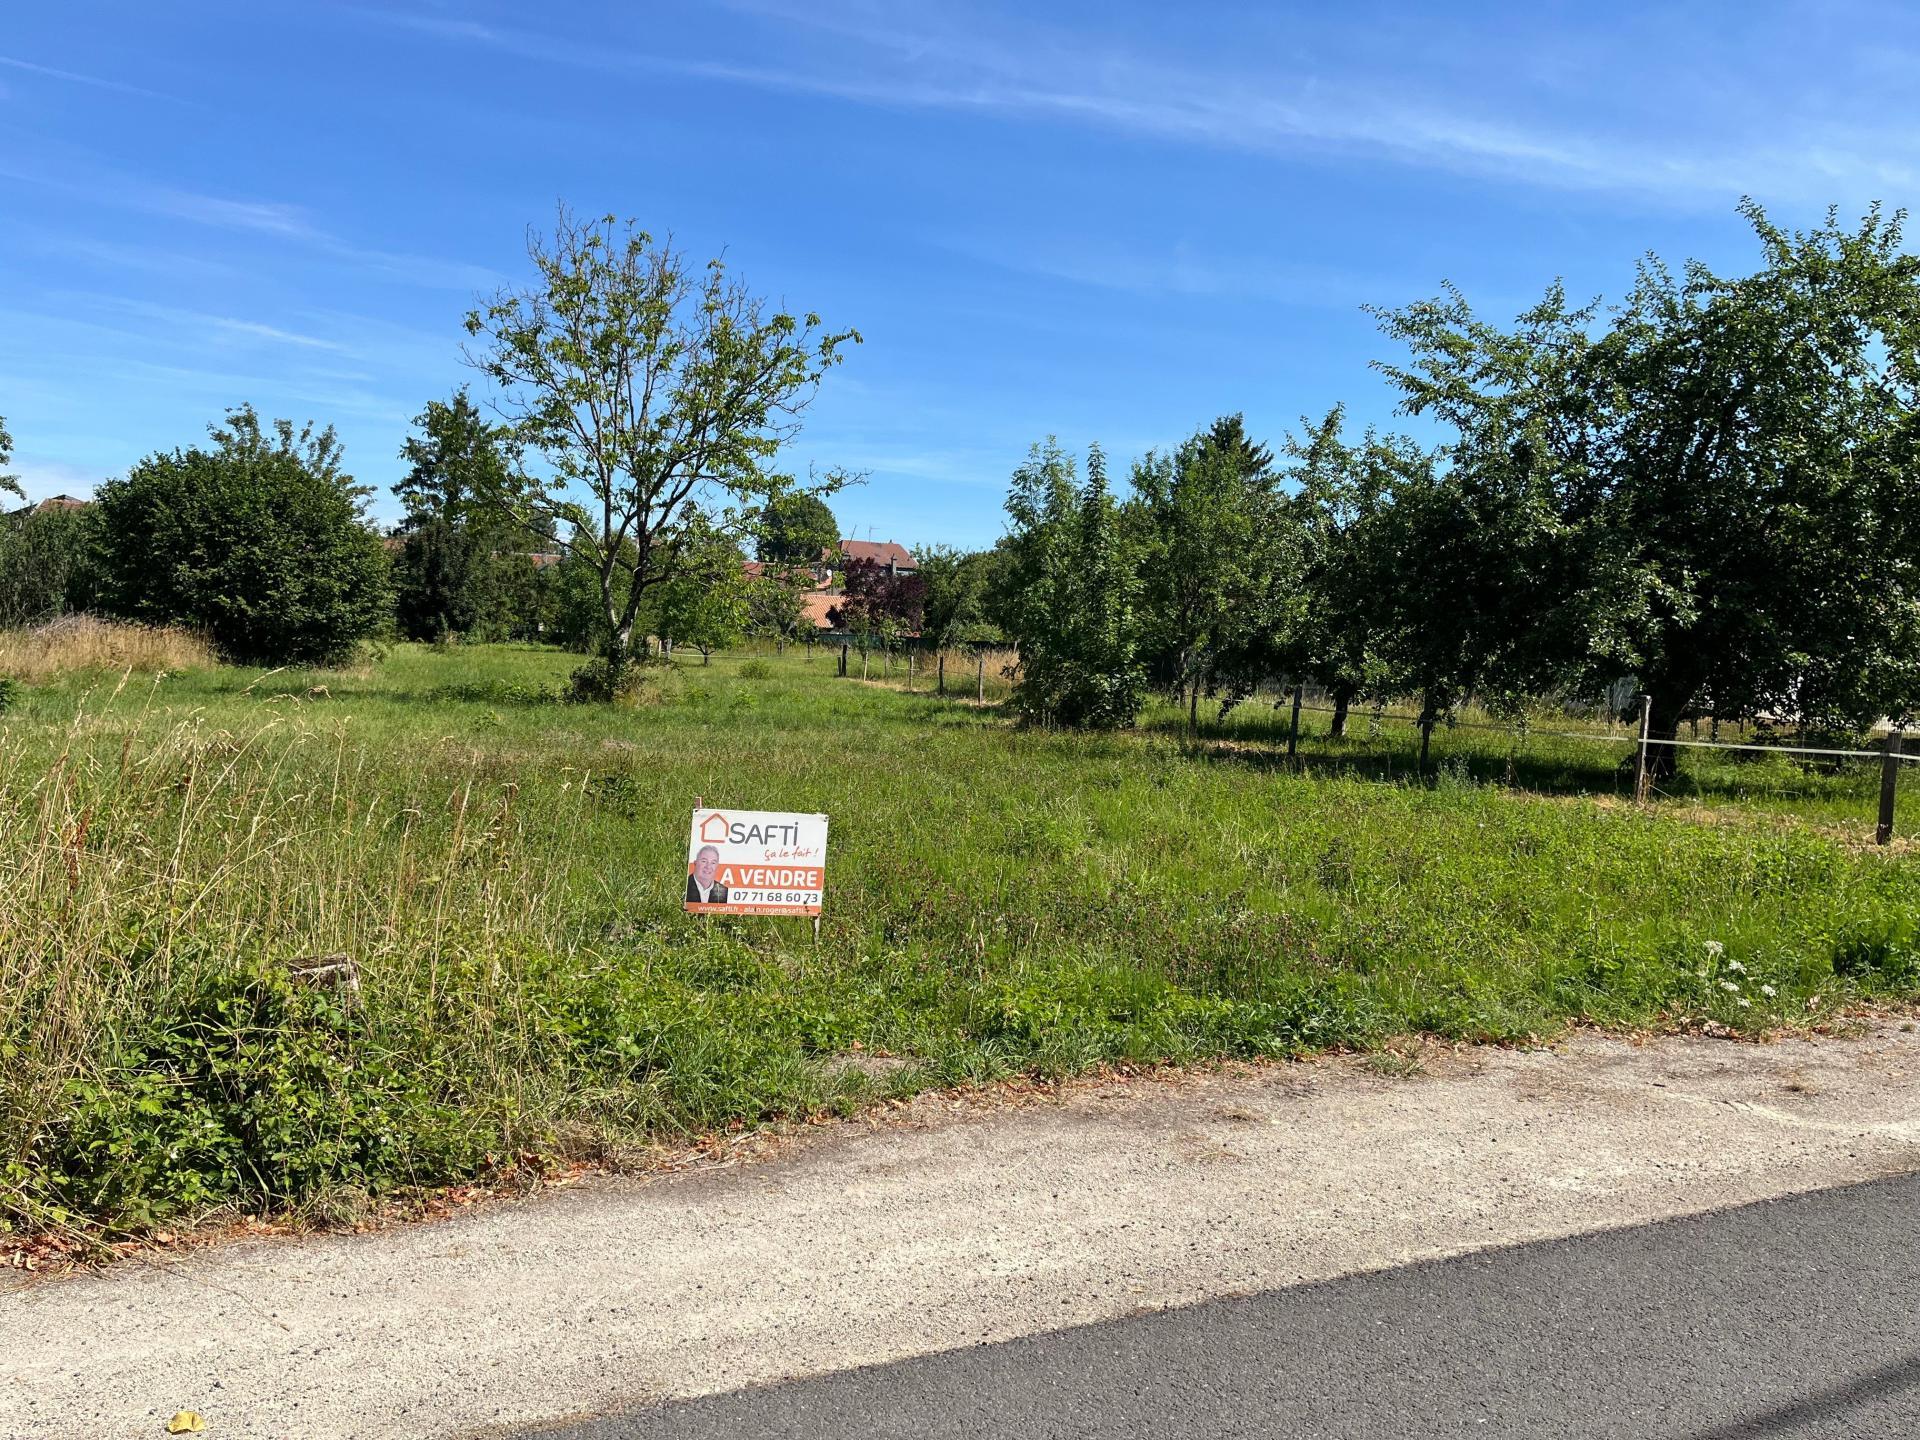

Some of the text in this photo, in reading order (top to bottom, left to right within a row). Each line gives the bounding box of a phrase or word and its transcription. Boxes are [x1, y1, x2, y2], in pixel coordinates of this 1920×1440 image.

[779, 848, 789, 858] le
[791, 846, 812, 860] fait
[720, 868, 818, 887] A VENDRE
[733, 891, 818, 904] 07 71 68 60 73
